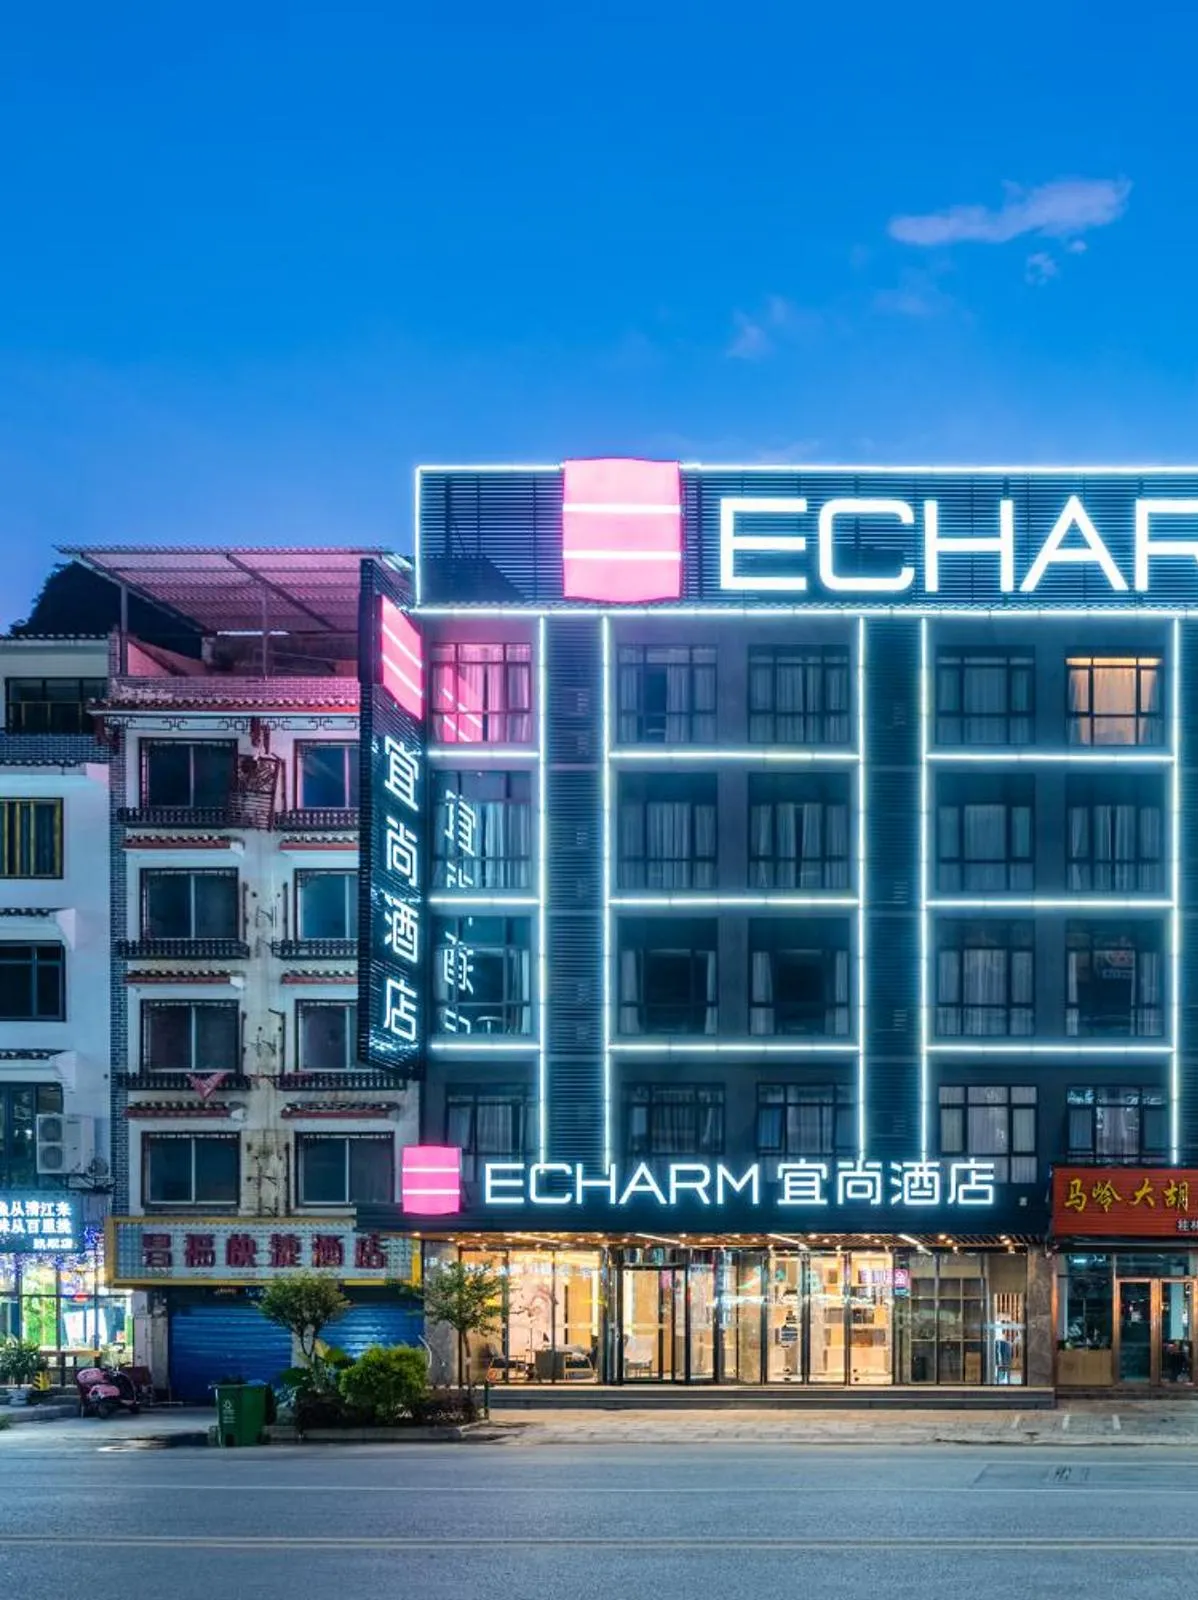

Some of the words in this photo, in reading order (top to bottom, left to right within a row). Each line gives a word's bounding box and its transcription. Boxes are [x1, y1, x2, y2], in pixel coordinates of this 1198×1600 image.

[384, 735, 419, 1043] 宜尚酒店
[485, 1163, 759, 1204] ECHARM
[777, 1159, 995, 1205] 宜尚酒店
